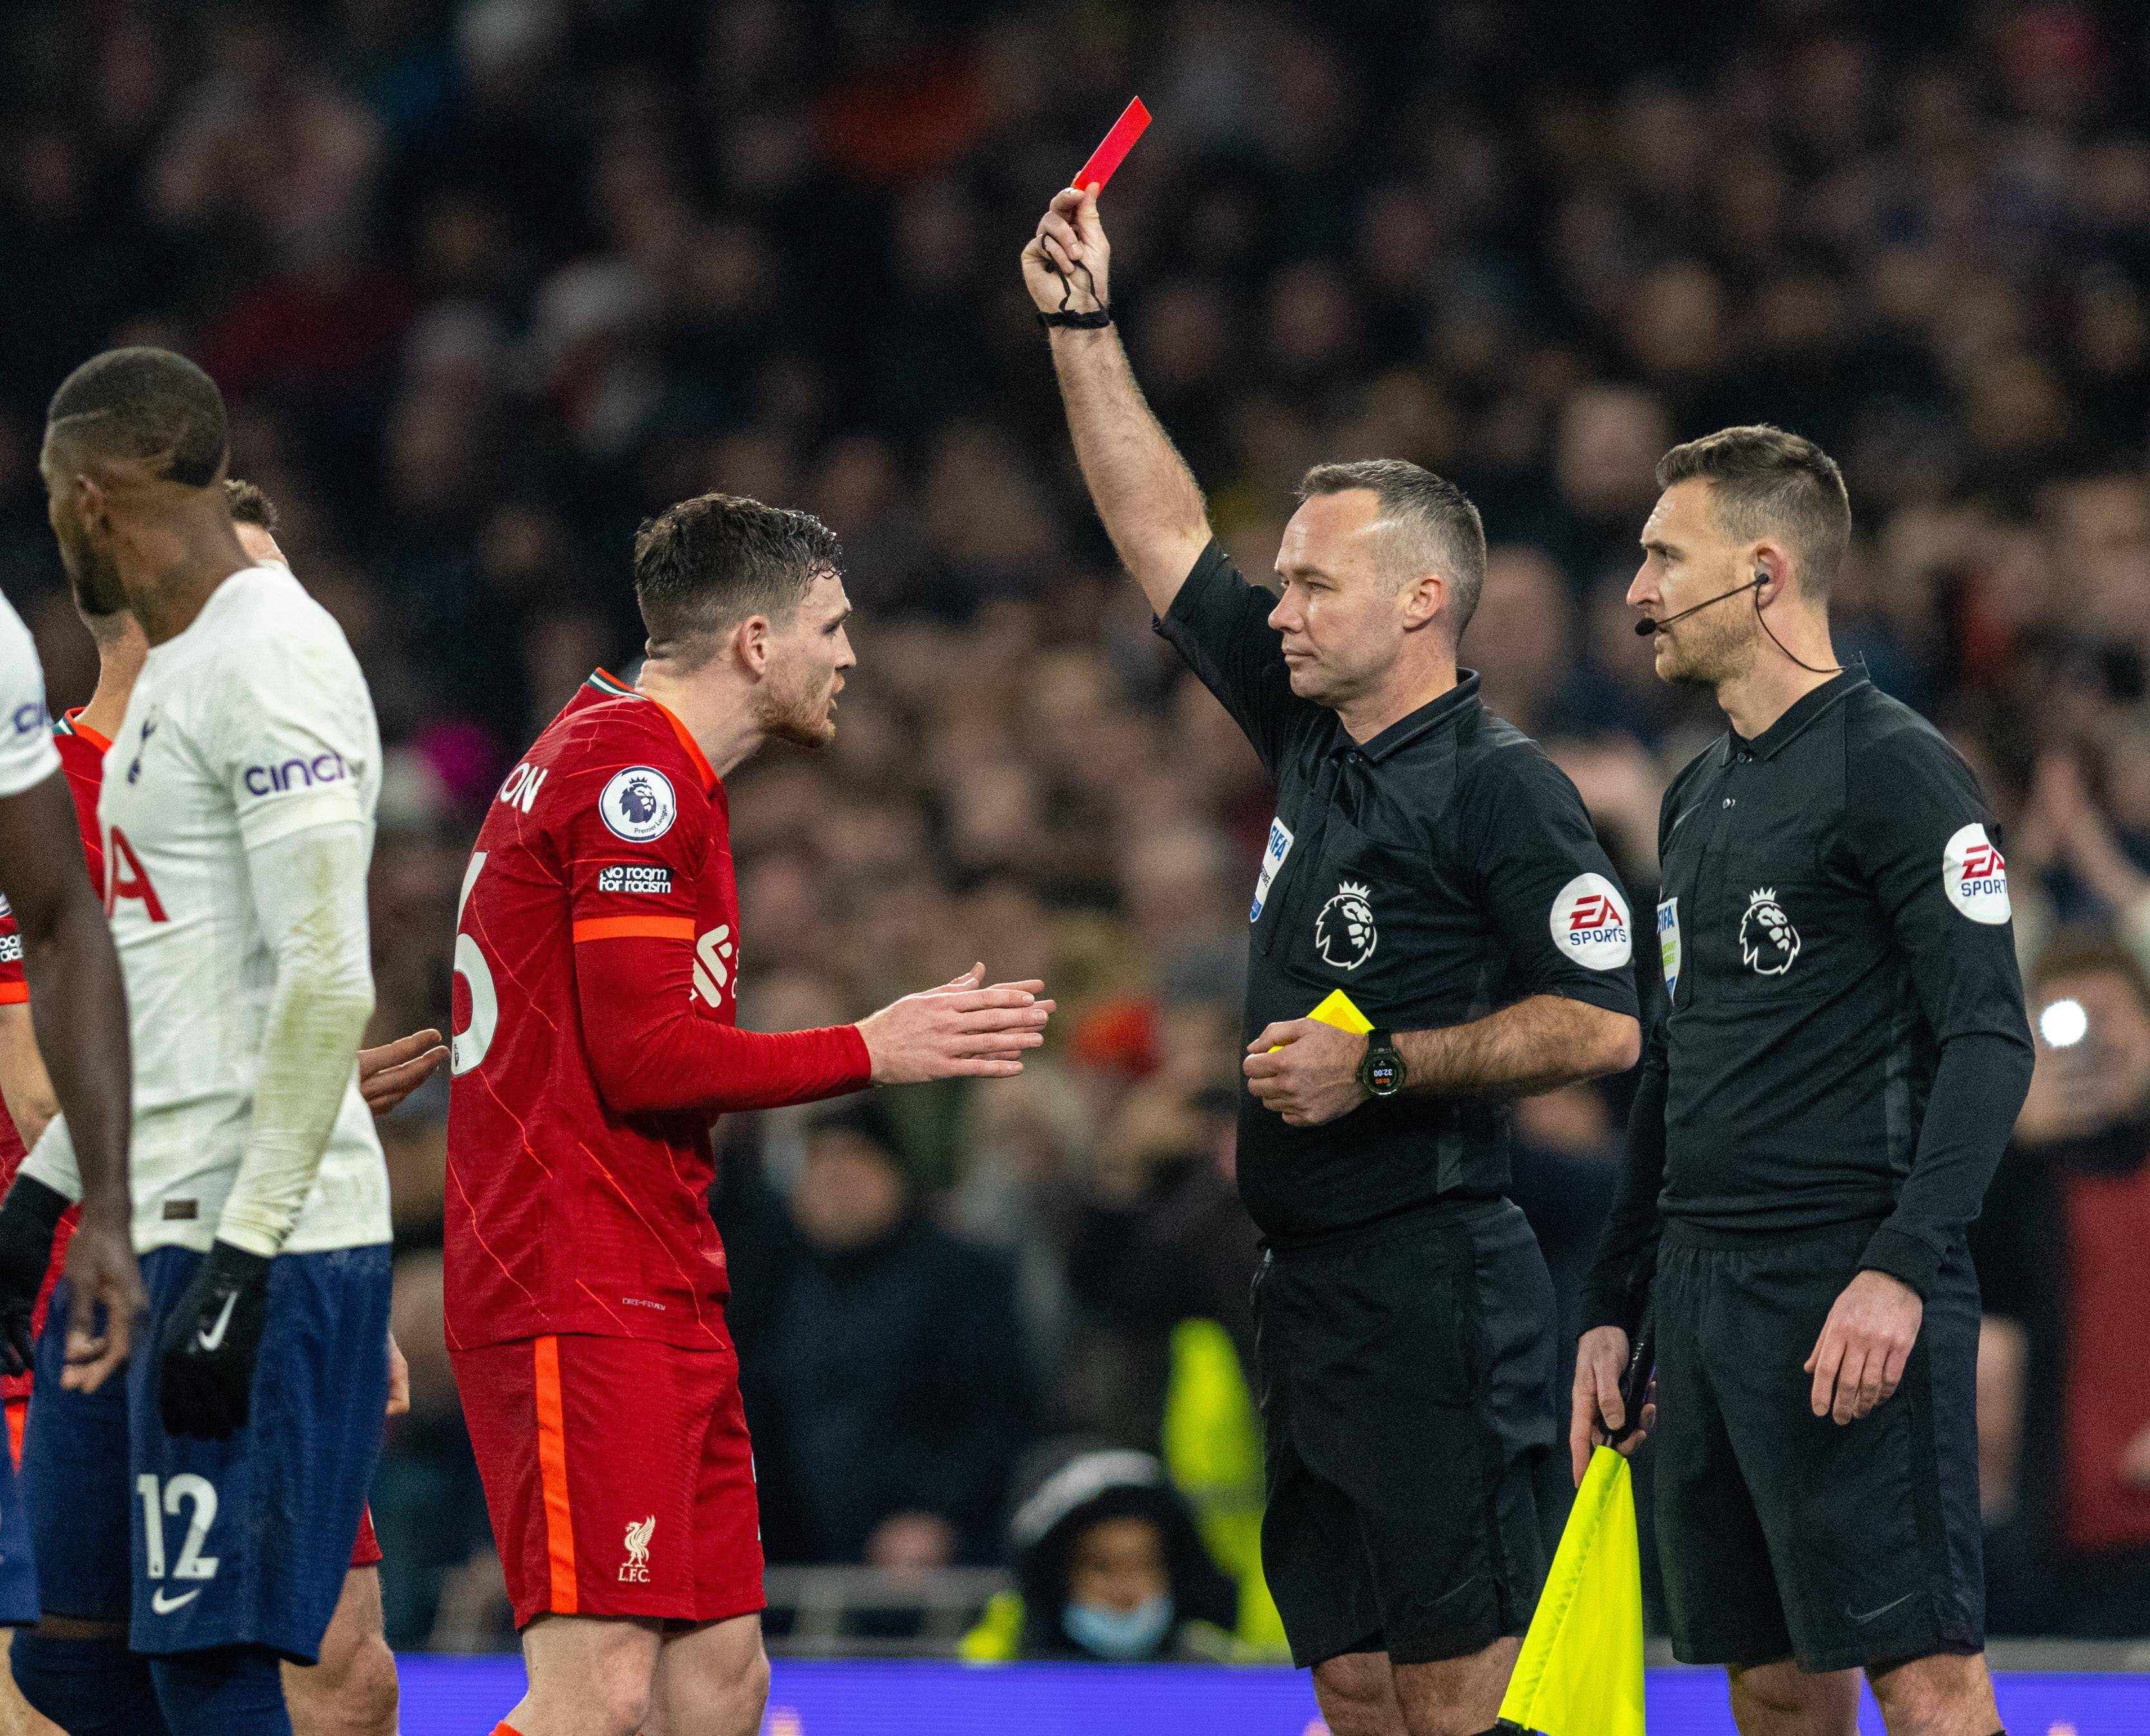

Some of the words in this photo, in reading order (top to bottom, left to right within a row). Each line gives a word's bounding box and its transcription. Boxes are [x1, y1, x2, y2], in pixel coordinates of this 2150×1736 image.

[634, 824, 657, 834] Premier
[654, 803, 668, 826] League
[626, 867, 667, 881] room
[1961, 844, 2005, 880] EA
[599, 876, 623, 892] for
[624, 880, 671, 894] racism
[1569, 895, 1623, 931] EA
[1569, 928, 1627, 946] SPORTS
[136, 1473, 220, 1579] 12
[618, 1567, 651, 1583] L.F.C.
